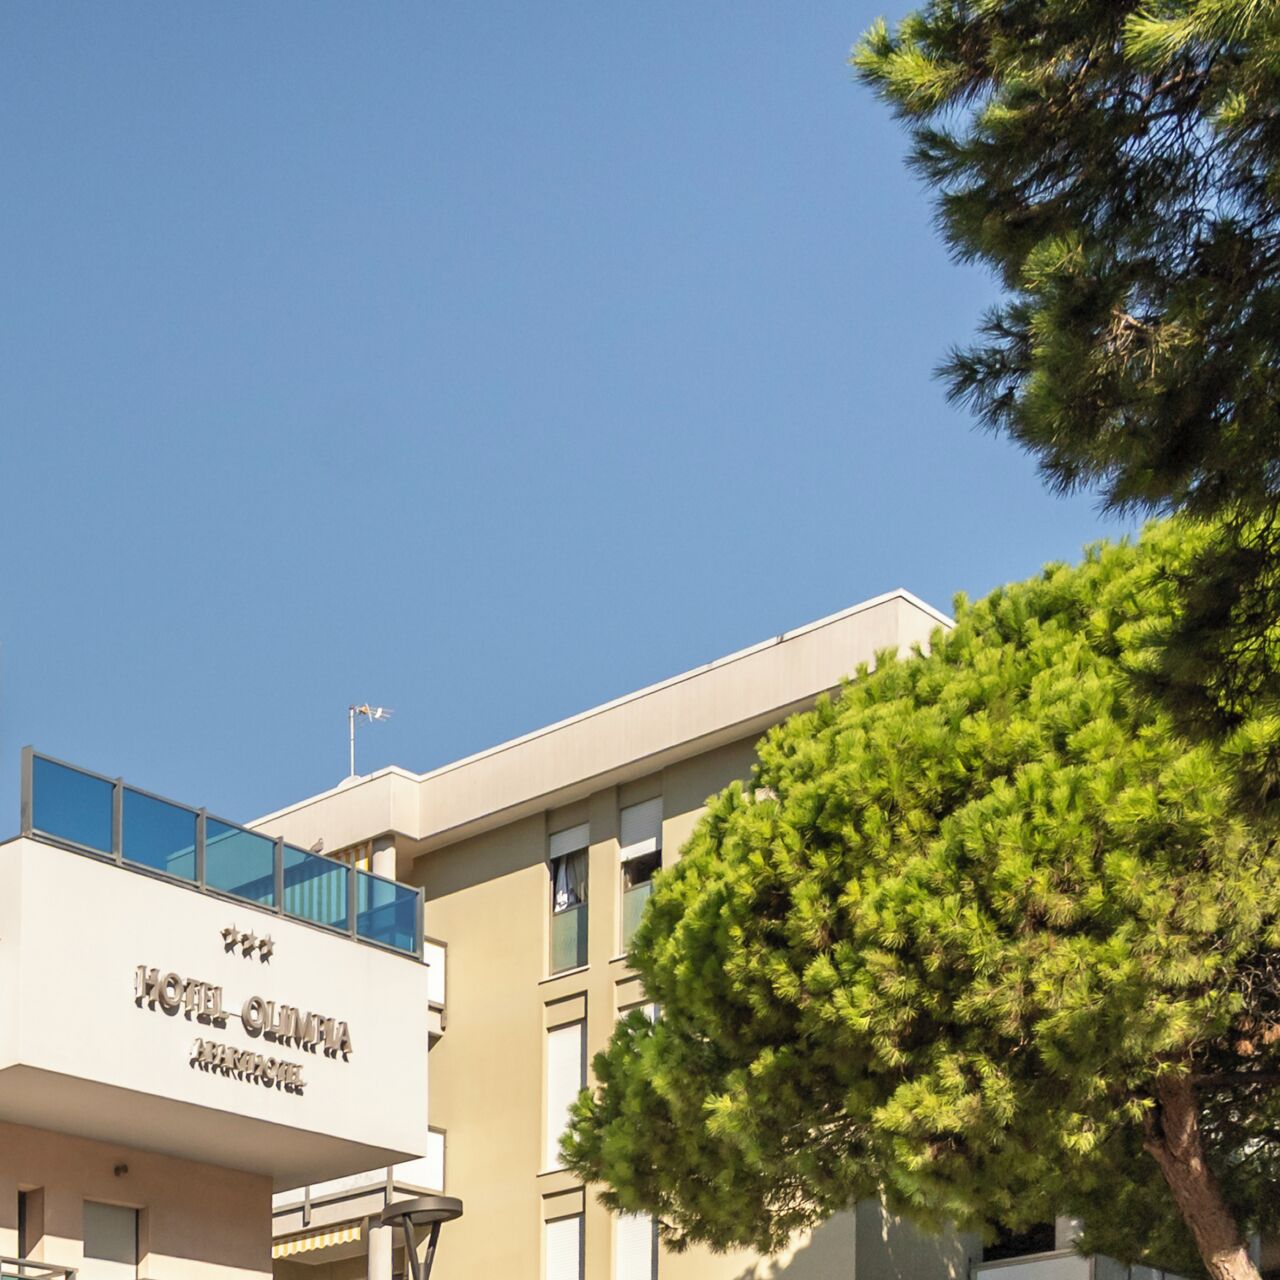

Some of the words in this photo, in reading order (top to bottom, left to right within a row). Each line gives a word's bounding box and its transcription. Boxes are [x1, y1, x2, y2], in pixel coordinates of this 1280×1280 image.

[134, 964, 230, 1024] HOTEL
[241, 995, 353, 1057] OLIMPIA
[190, 1037, 308, 1090] APARTHOTEL
